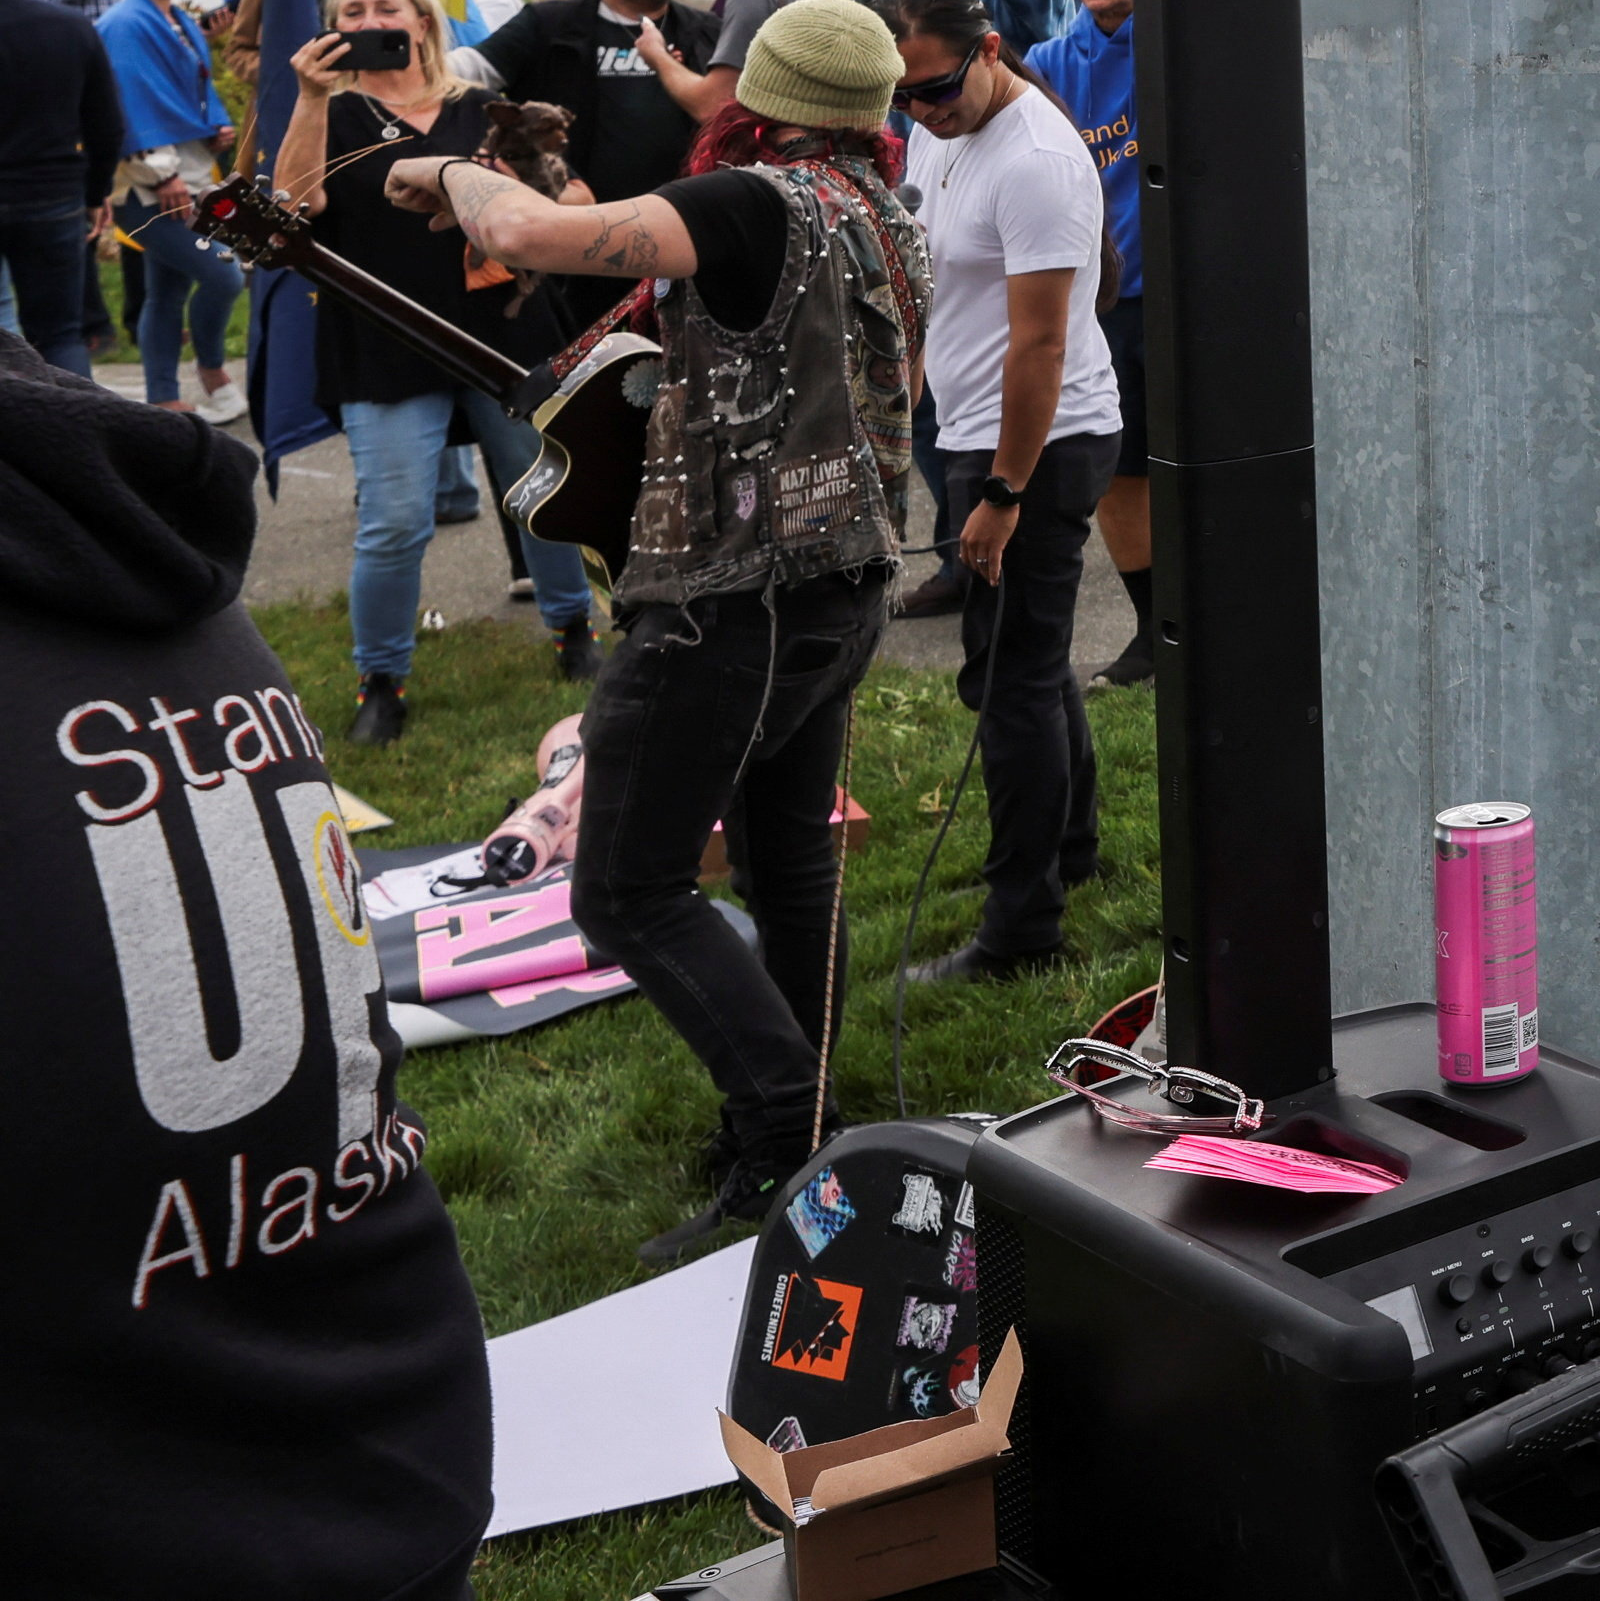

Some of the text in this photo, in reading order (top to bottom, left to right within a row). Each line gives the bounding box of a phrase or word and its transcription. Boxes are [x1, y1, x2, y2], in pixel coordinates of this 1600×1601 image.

[1080, 114, 1129, 145] and
[779, 457, 849, 492] NAZI LIVES
[811, 478, 850, 501] MATTER
[57, 686, 326, 823] Stan
[1521, 1234, 1535, 1244] BASS
[1481, 1249, 1494, 1258] GAIN
[1431, 1260, 1463, 1277] MAIN MENU
[761, 1274, 788, 1362] CODEFENDANTS
[1460, 1332, 1474, 1342] BACK
